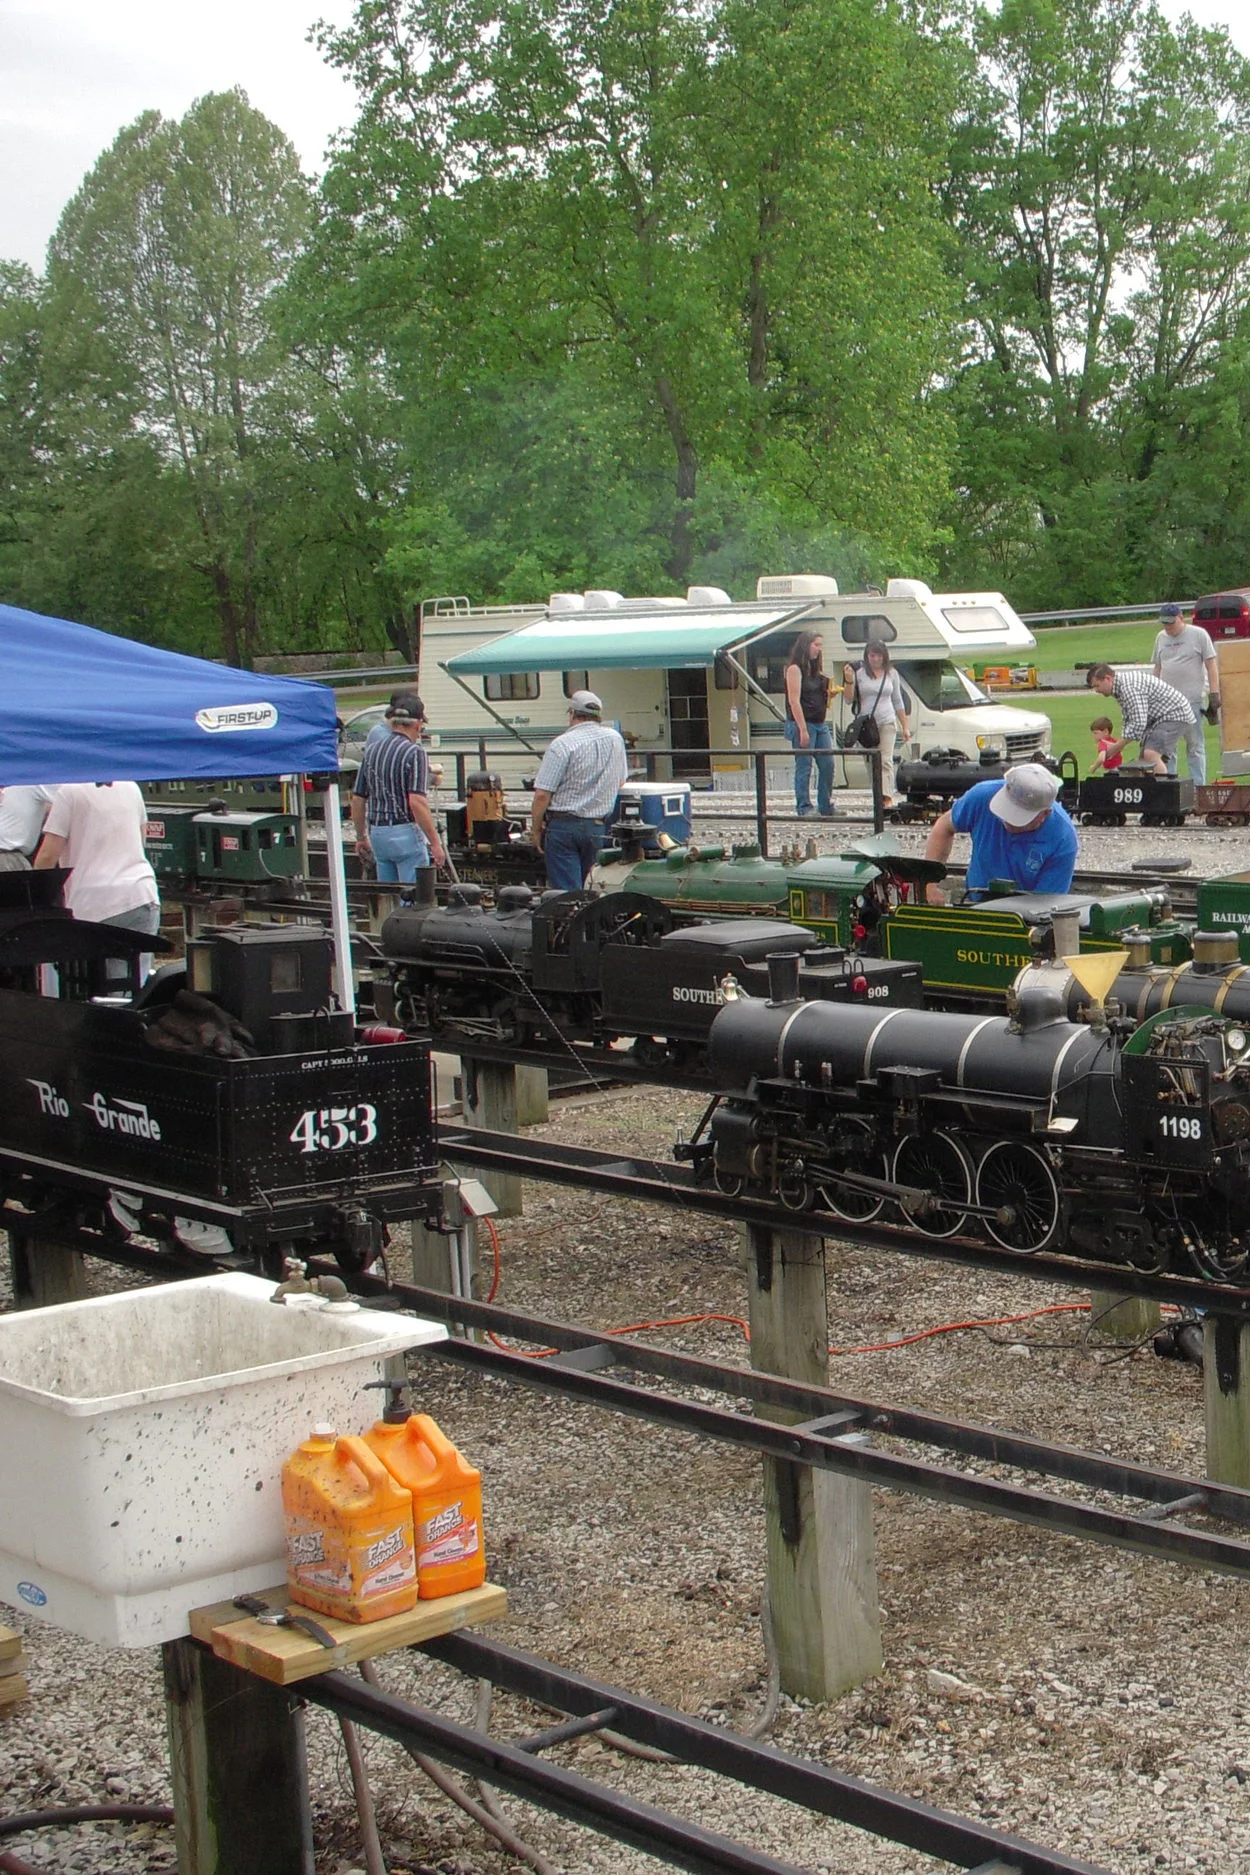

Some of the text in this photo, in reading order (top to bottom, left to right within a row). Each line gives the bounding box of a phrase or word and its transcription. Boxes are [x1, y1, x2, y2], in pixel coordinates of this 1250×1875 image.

[1114, 788, 1143, 803] 989
[956, 949, 1033, 967] SOUTHE
[672, 986, 724, 1006] SOUTHE
[868, 985, 889, 999] 908
[26, 1078, 161, 1141] Rio Grande
[290, 1103, 377, 1153] 453
[1159, 1115, 1202, 1140] 1198
[426, 1514, 464, 1543] ORANGE
[427, 1500, 463, 1532] FAST
[367, 1526, 403, 1557] FAST
[369, 1541, 405, 1569] ORANGE
